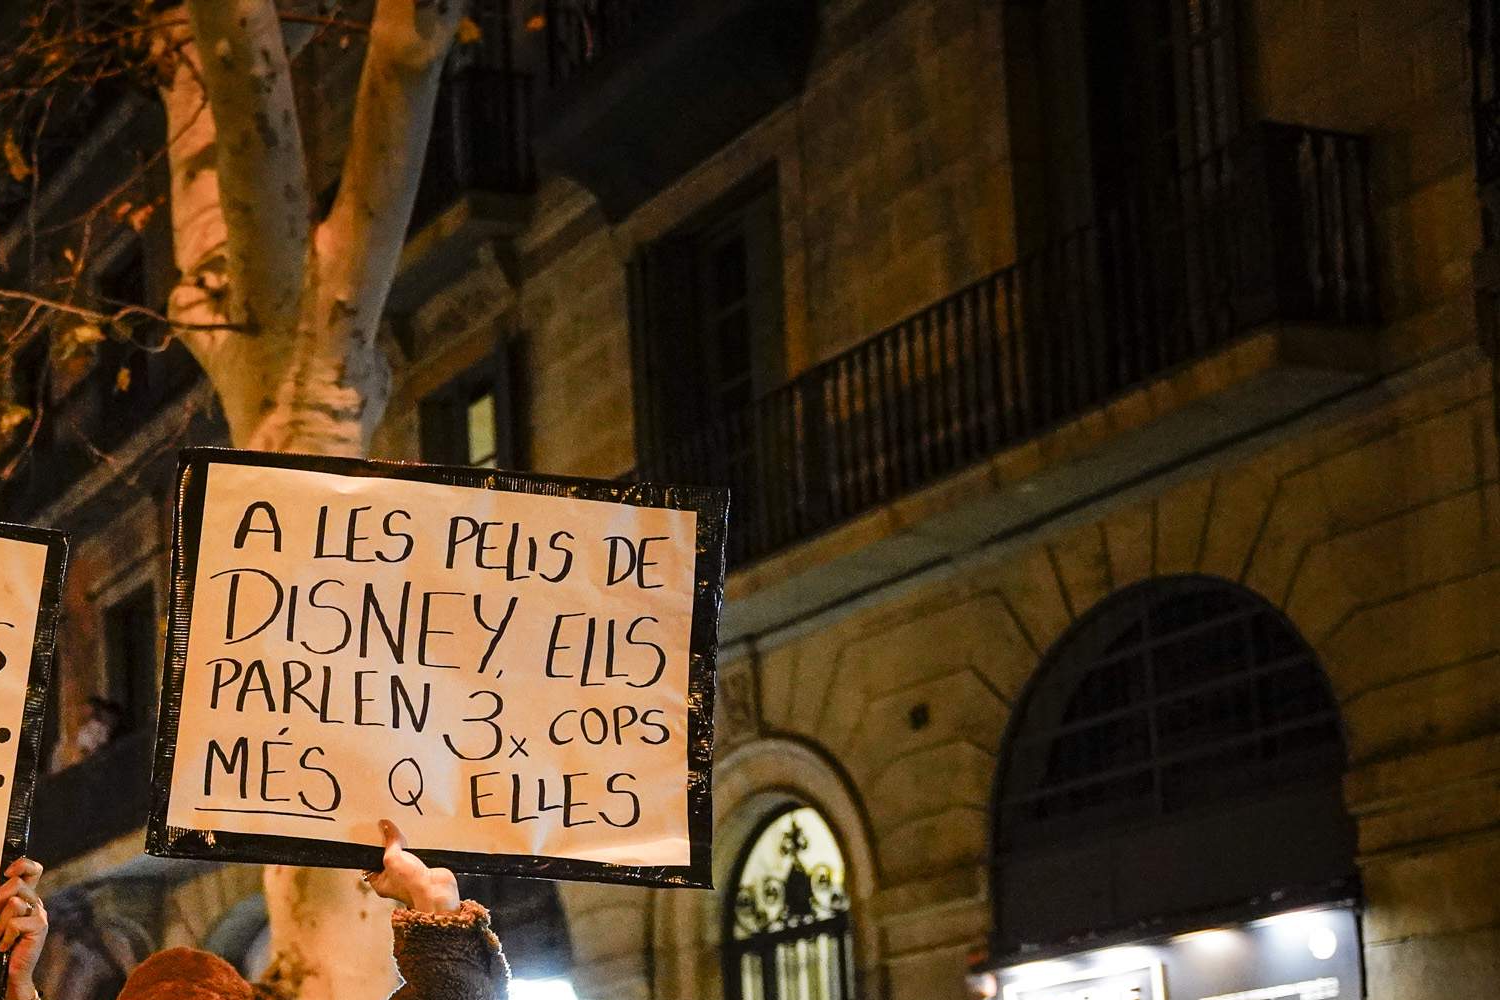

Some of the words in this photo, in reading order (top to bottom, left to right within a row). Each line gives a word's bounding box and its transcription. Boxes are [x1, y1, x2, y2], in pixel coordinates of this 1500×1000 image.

[233, 501, 283, 552] A
[313, 505, 415, 563] LES
[445, 515, 575, 583] PELIS
[603, 535, 670, 589] DE
[209, 567, 519, 680] DISNEY,
[545, 612, 667, 688] ELLS
[205, 657, 431, 733] PARLEN
[547, 707, 671, 746] COPS
[203, 726, 342, 812] MÉS
[387, 757, 425, 816] Q
[470, 772, 641, 829] ELLES
